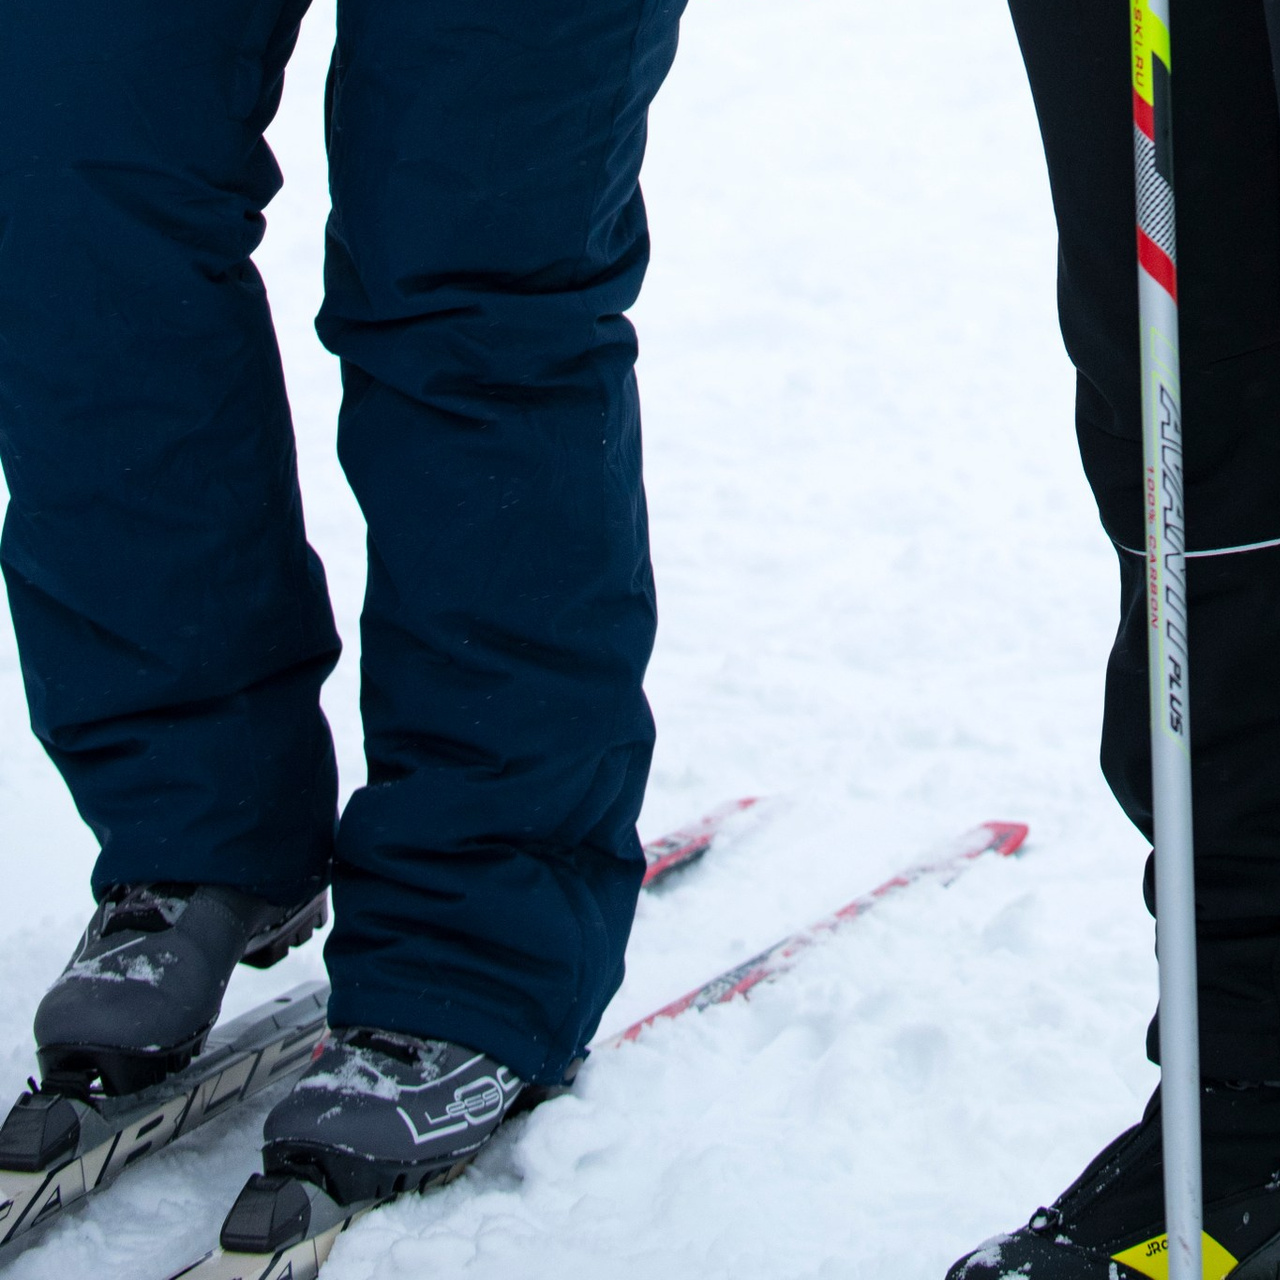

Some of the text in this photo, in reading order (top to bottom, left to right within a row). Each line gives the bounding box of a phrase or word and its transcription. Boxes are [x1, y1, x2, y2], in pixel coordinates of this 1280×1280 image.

[1147, 465, 1160, 629] 100% CARBON
[1167, 654, 1184, 737] PLUS
